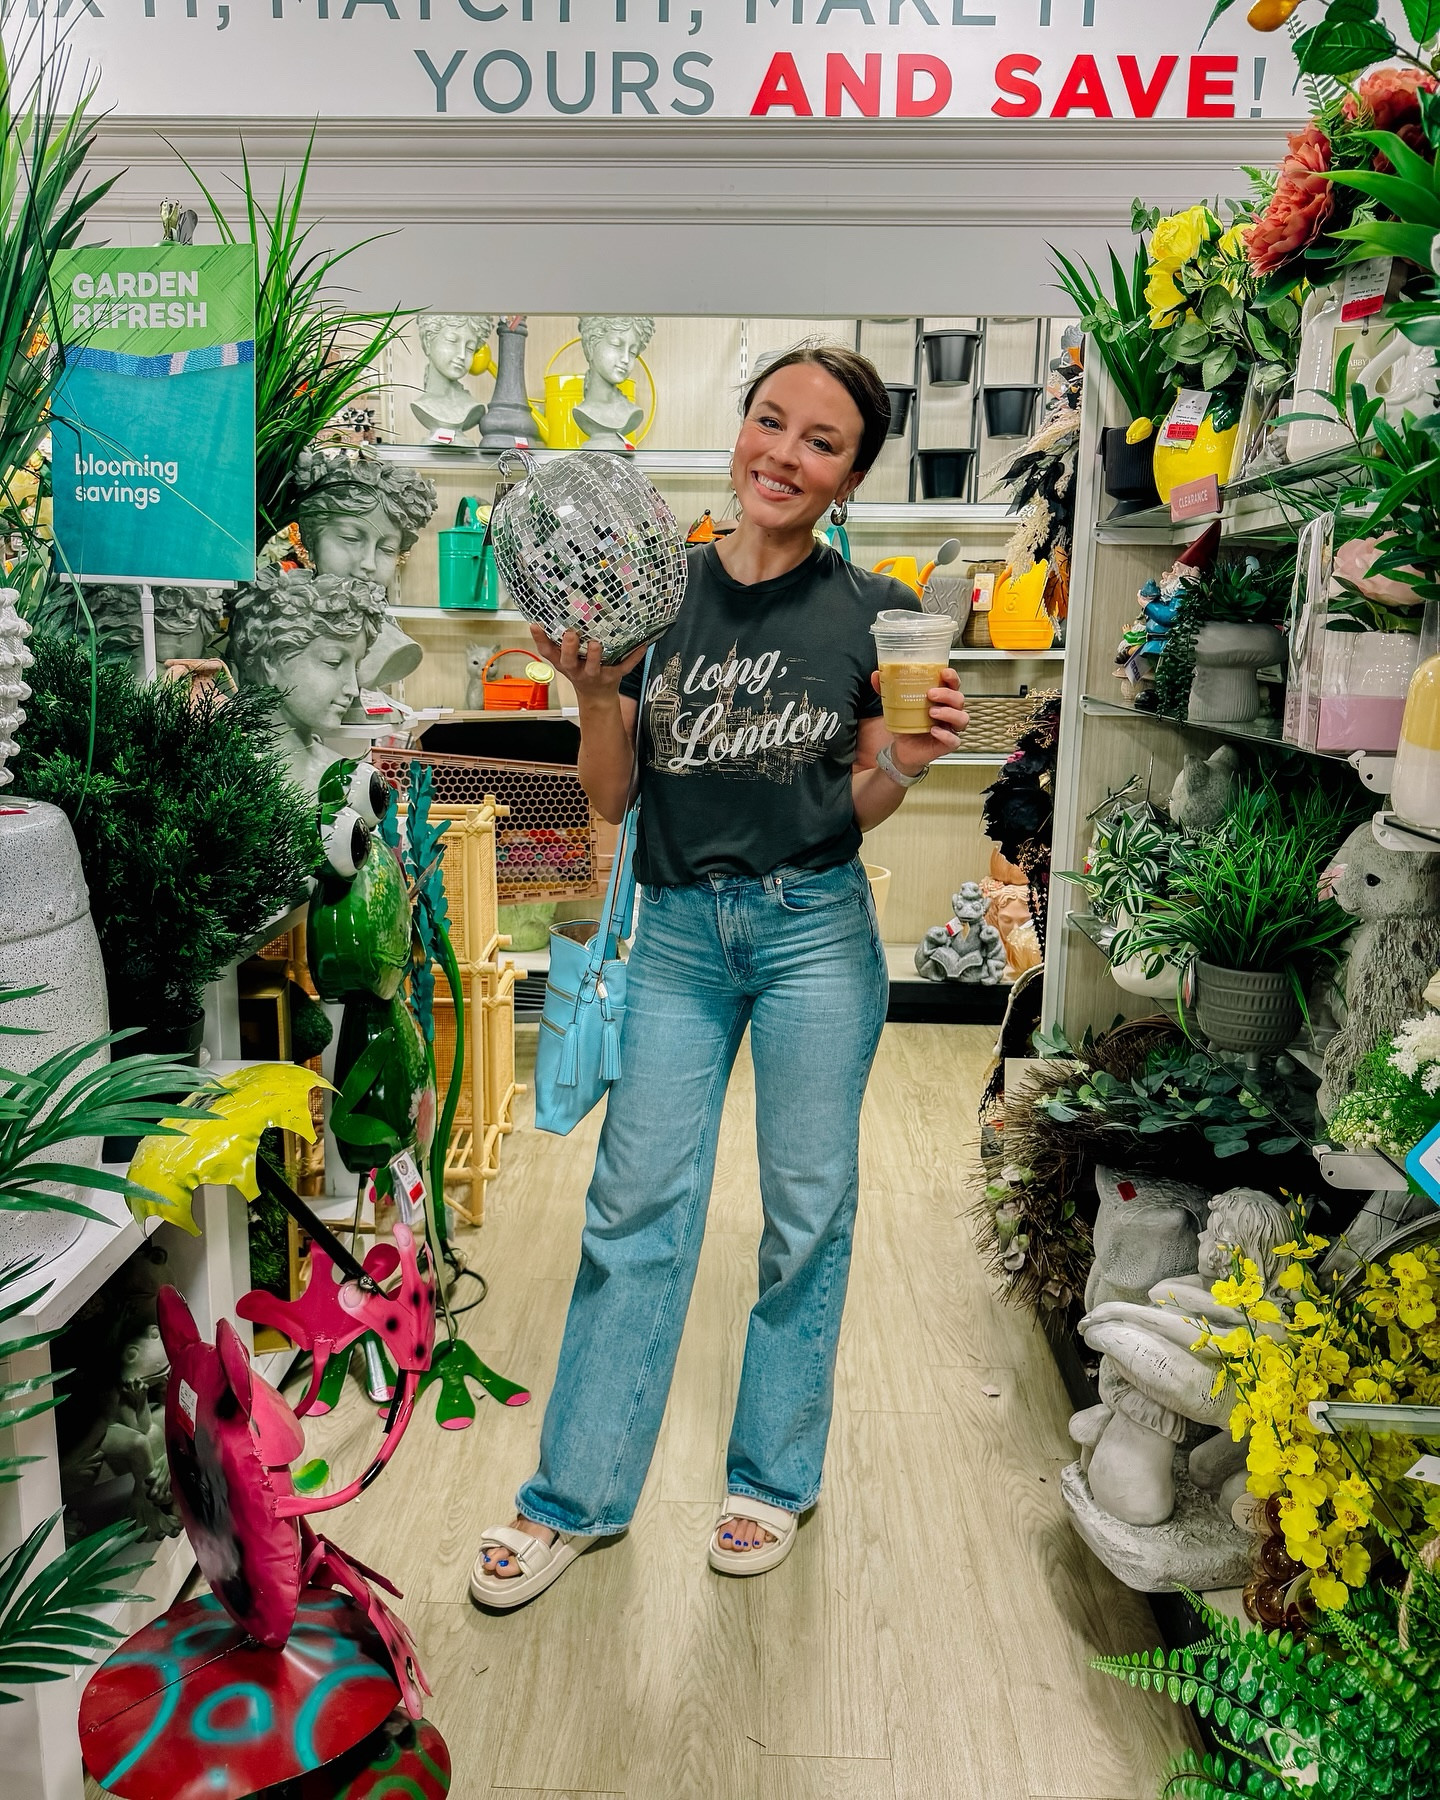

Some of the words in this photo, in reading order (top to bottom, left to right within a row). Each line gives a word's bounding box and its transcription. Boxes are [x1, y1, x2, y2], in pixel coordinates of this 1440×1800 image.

[413, 49, 715, 116] YOURS
[749, 52, 953, 117] AND
[991, 53, 1267, 118] SAVE!
[72, 270, 199, 299] GARDEN
[72, 302, 207, 329] REFRESH
[75, 454, 178, 484] blooming
[75, 481, 161, 510] savings
[1178, 489, 1209, 509] CLEARANCE
[683, 650, 788, 695] long,
[667, 701, 842, 770] London
